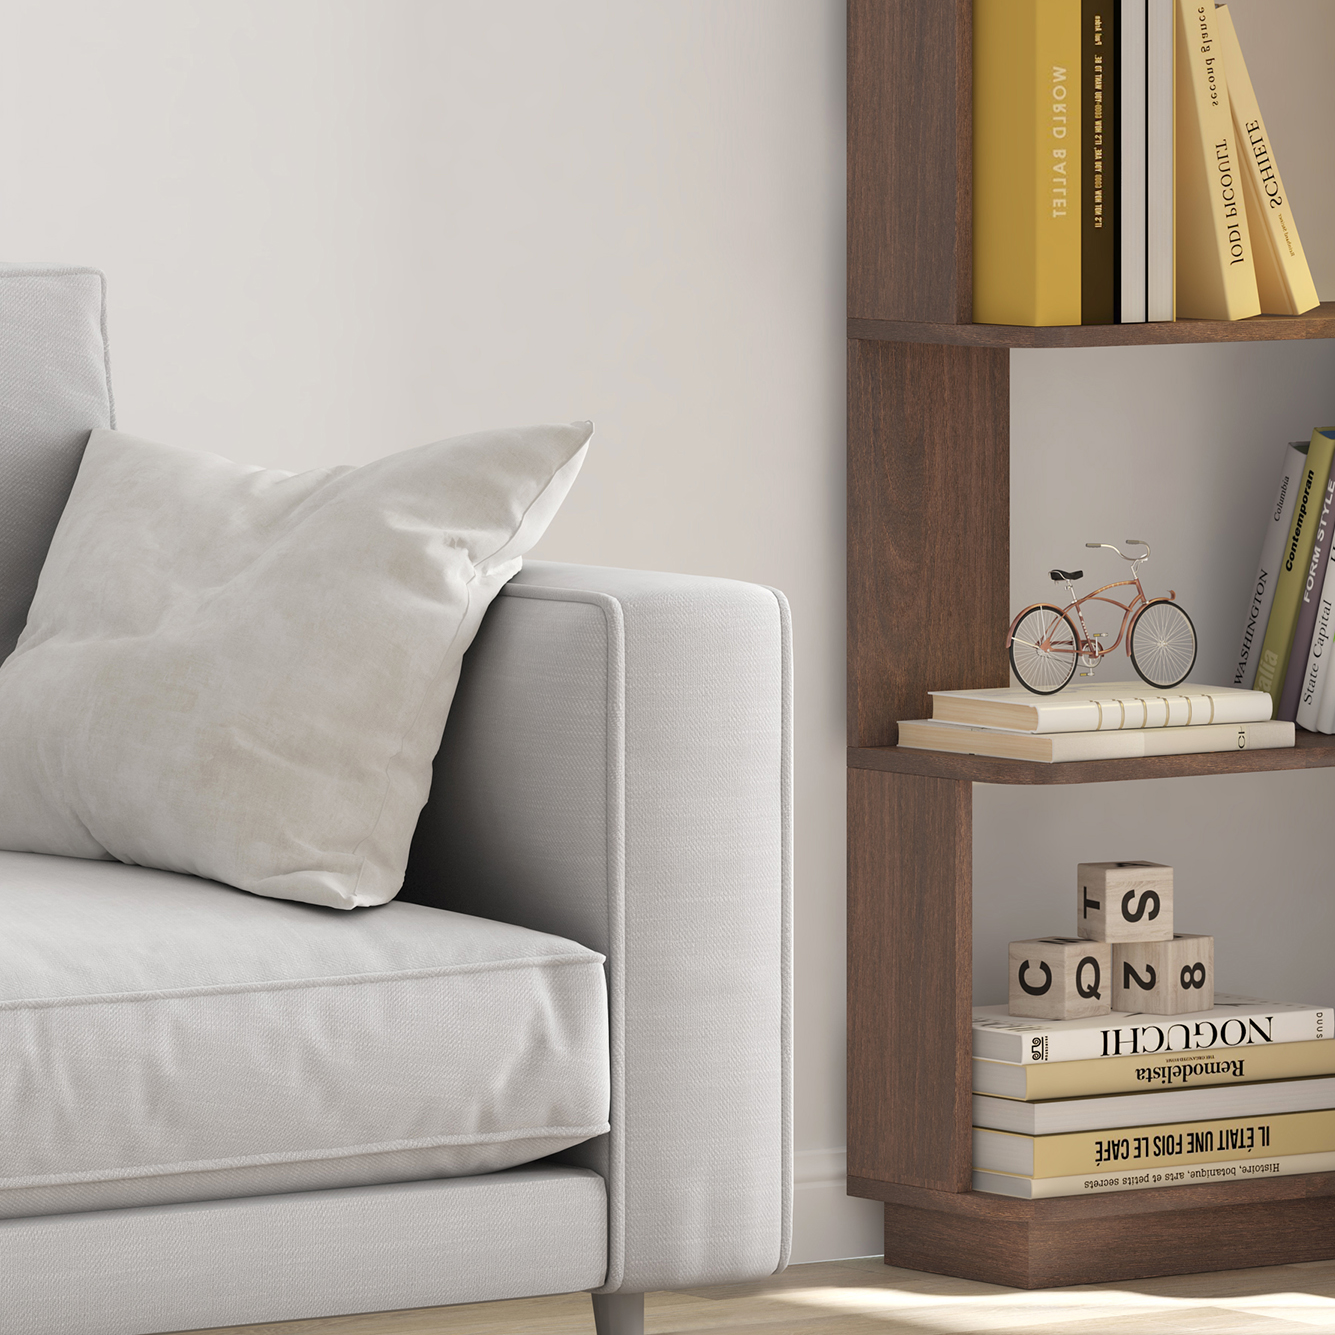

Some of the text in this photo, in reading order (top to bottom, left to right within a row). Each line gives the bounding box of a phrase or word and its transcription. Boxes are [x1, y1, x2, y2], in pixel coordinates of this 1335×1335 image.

[1285, 470, 1314, 572] Contemporan
[1303, 479, 1335, 603] FORM STYLE
[1234, 476, 1290, 685] WASHINGTON Columbia
[1304, 663, 1320, 706] State
[1313, 599, 1332, 659] Capital
[1083, 886, 1100, 919] T
[1121, 889, 1160, 923] S
[1018, 960, 1053, 996] C
[1076, 956, 1101, 1001] Q
[1123, 961, 1157, 991] 2
[1180, 962, 1206, 990] 8
[1100, 1016, 1273, 1057] NOGUCHI
[1135, 1059, 1245, 1084] Remodelista
[1095, 1126, 1270, 1166] IL ÉTAIT UNE FOIS LE CAFÉ
[1084, 1163, 1280, 1189] Histoire, botanique, arts et petits secrets
